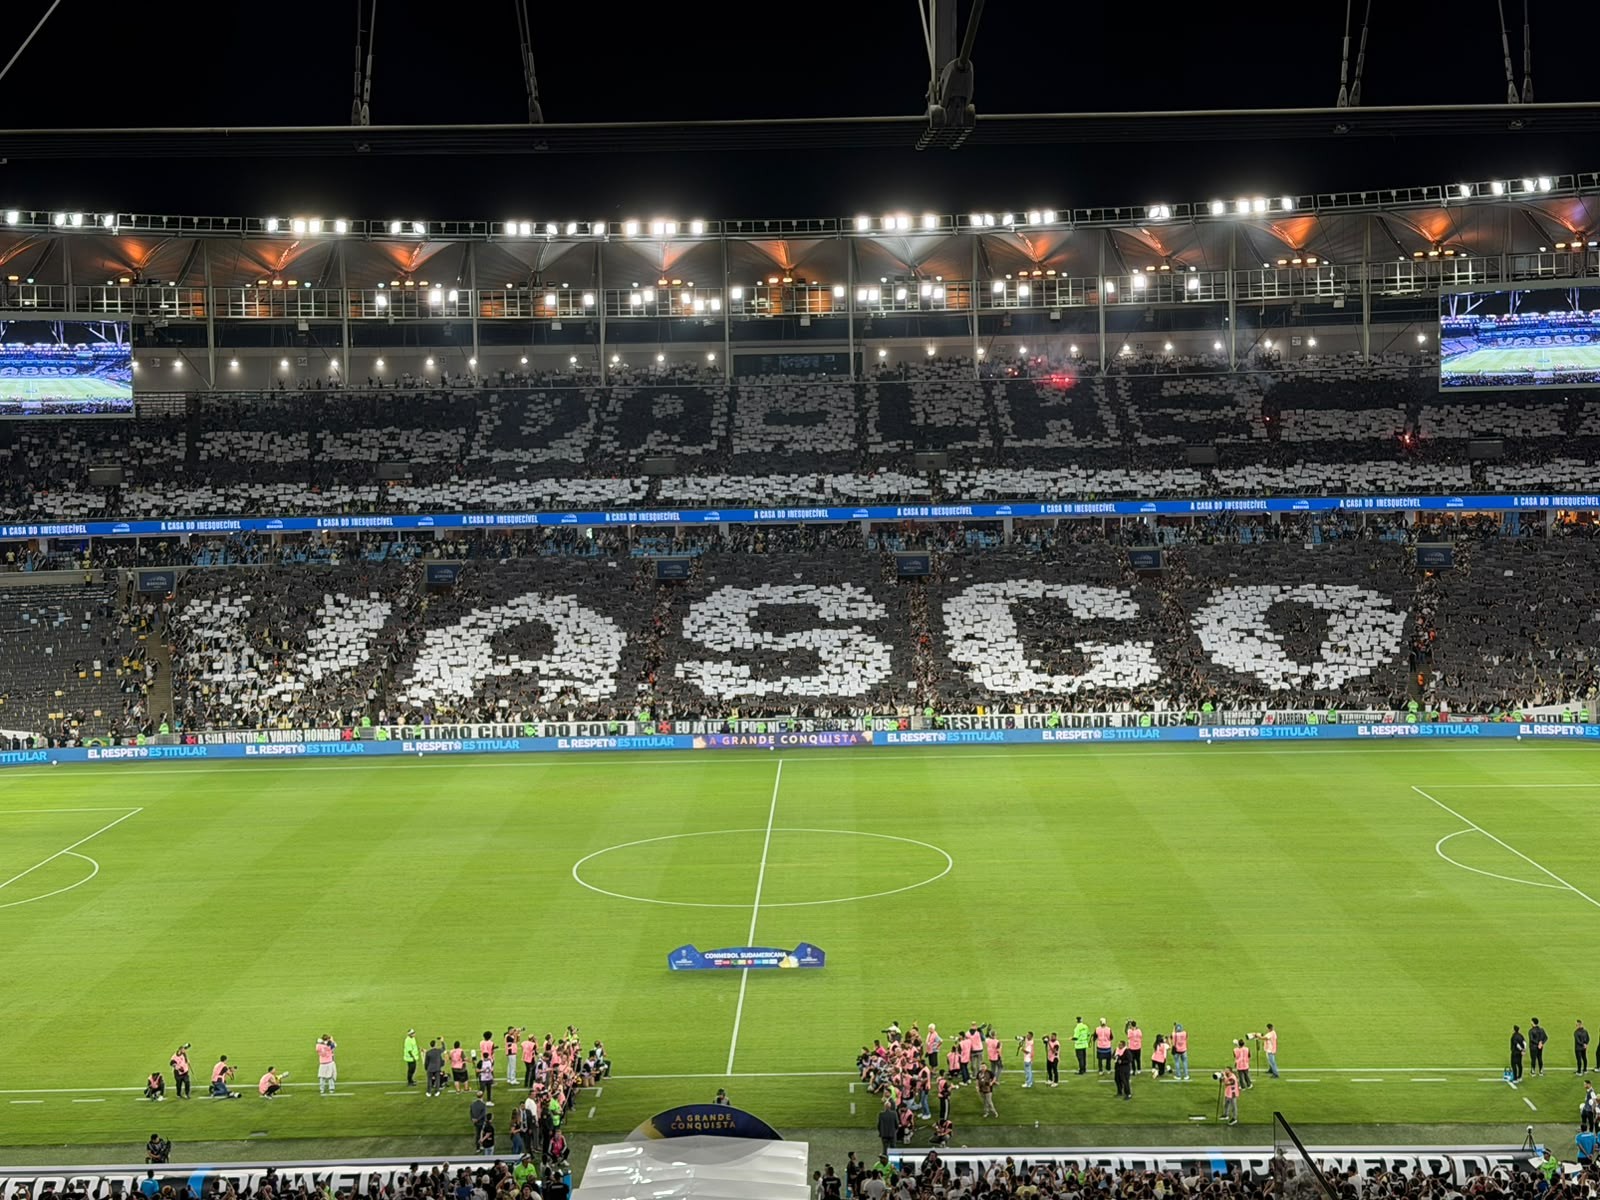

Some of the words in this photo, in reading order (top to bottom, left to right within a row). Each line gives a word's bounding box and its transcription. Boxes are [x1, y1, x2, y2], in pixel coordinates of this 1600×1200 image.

[1497, 334, 1590, 346] VASCO
[1190, 501, 1195, 510] A
[1196, 501, 1213, 510] CASA
[1214, 501, 1223, 509] DO
[1339, 500, 1345, 508] A
[1346, 499, 1363, 508] CASA
[1364, 499, 1374, 507] DO
[1513, 497, 1518, 506] A
[1520, 497, 1538, 506] CASA
[1539, 497, 1549, 506] DO
[897, 507, 902, 516] A
[903, 507, 919, 516] CASA
[920, 507, 929, 516] DO
[1040, 504, 1045, 513] A
[1046, 504, 1063, 513] CASA
[1064, 504, 1073, 512] DO
[605, 513, 610, 521] A
[611, 513, 627, 521] CASA
[628, 512, 637, 521] DO
[754, 510, 759, 518] A
[760, 510, 776, 518] CASA
[777, 510, 786, 518] DO
[317, 518, 322, 527] A
[323, 518, 340, 527] CASA
[341, 518, 350, 526] DO
[462, 515, 467, 524] A
[468, 515, 484, 524] CASA
[485, 515, 494, 524] DO
[161, 521, 166, 530] A
[167, 521, 185, 530] CASA
[187, 521, 195, 530] DO
[2, 527, 8, 536] A
[9, 527, 27, 536] CASA
[28, 526, 38, 535] DO
[170, 578, 1406, 707] VASCO
[477, 723, 538, 739] CLUB
[544, 723, 570, 738] DO
[675, 720, 690, 734] EU
[1199, 728, 1212, 737] EL
[1260, 728, 1272, 736] ES
[1273, 727, 1318, 736] TITULAR
[1358, 726, 1370, 735] EL
[1420, 726, 1434, 734] ES
[1435, 724, 1480, 734] TITULAR
[1520, 726, 1532, 734] EL
[1585, 726, 1600, 736] ES
[269, 729, 303, 743] VAMOS
[709, 736, 717, 745] A
[722, 735, 775, 745] GRANDE
[780, 734, 857, 745] CONQUISTA
[888, 733, 899, 742] EL
[947, 732, 960, 741] ES
[961, 732, 1004, 741] TITULAR
[1042, 730, 1056, 740] EL
[1102, 730, 1115, 738] ES
[1116, 729, 1160, 738] TITULAR
[403, 742, 415, 751] EL
[463, 741, 475, 750] ES
[476, 740, 520, 750] TITULAR
[558, 738, 570, 748] EL
[618, 738, 630, 747] ES
[631, 737, 674, 746] TITULAR
[88, 748, 100, 758] EL
[150, 747, 162, 756] ES
[162, 746, 207, 756] TITULAR
[246, 746, 258, 755] EL
[306, 744, 320, 753] ES
[320, 744, 364, 752] TITULAR
[0, 751, 47, 762] TITULAR
[687, 1113, 732, 1122] GRANDE
[671, 1121, 736, 1130] CONQUISTA
